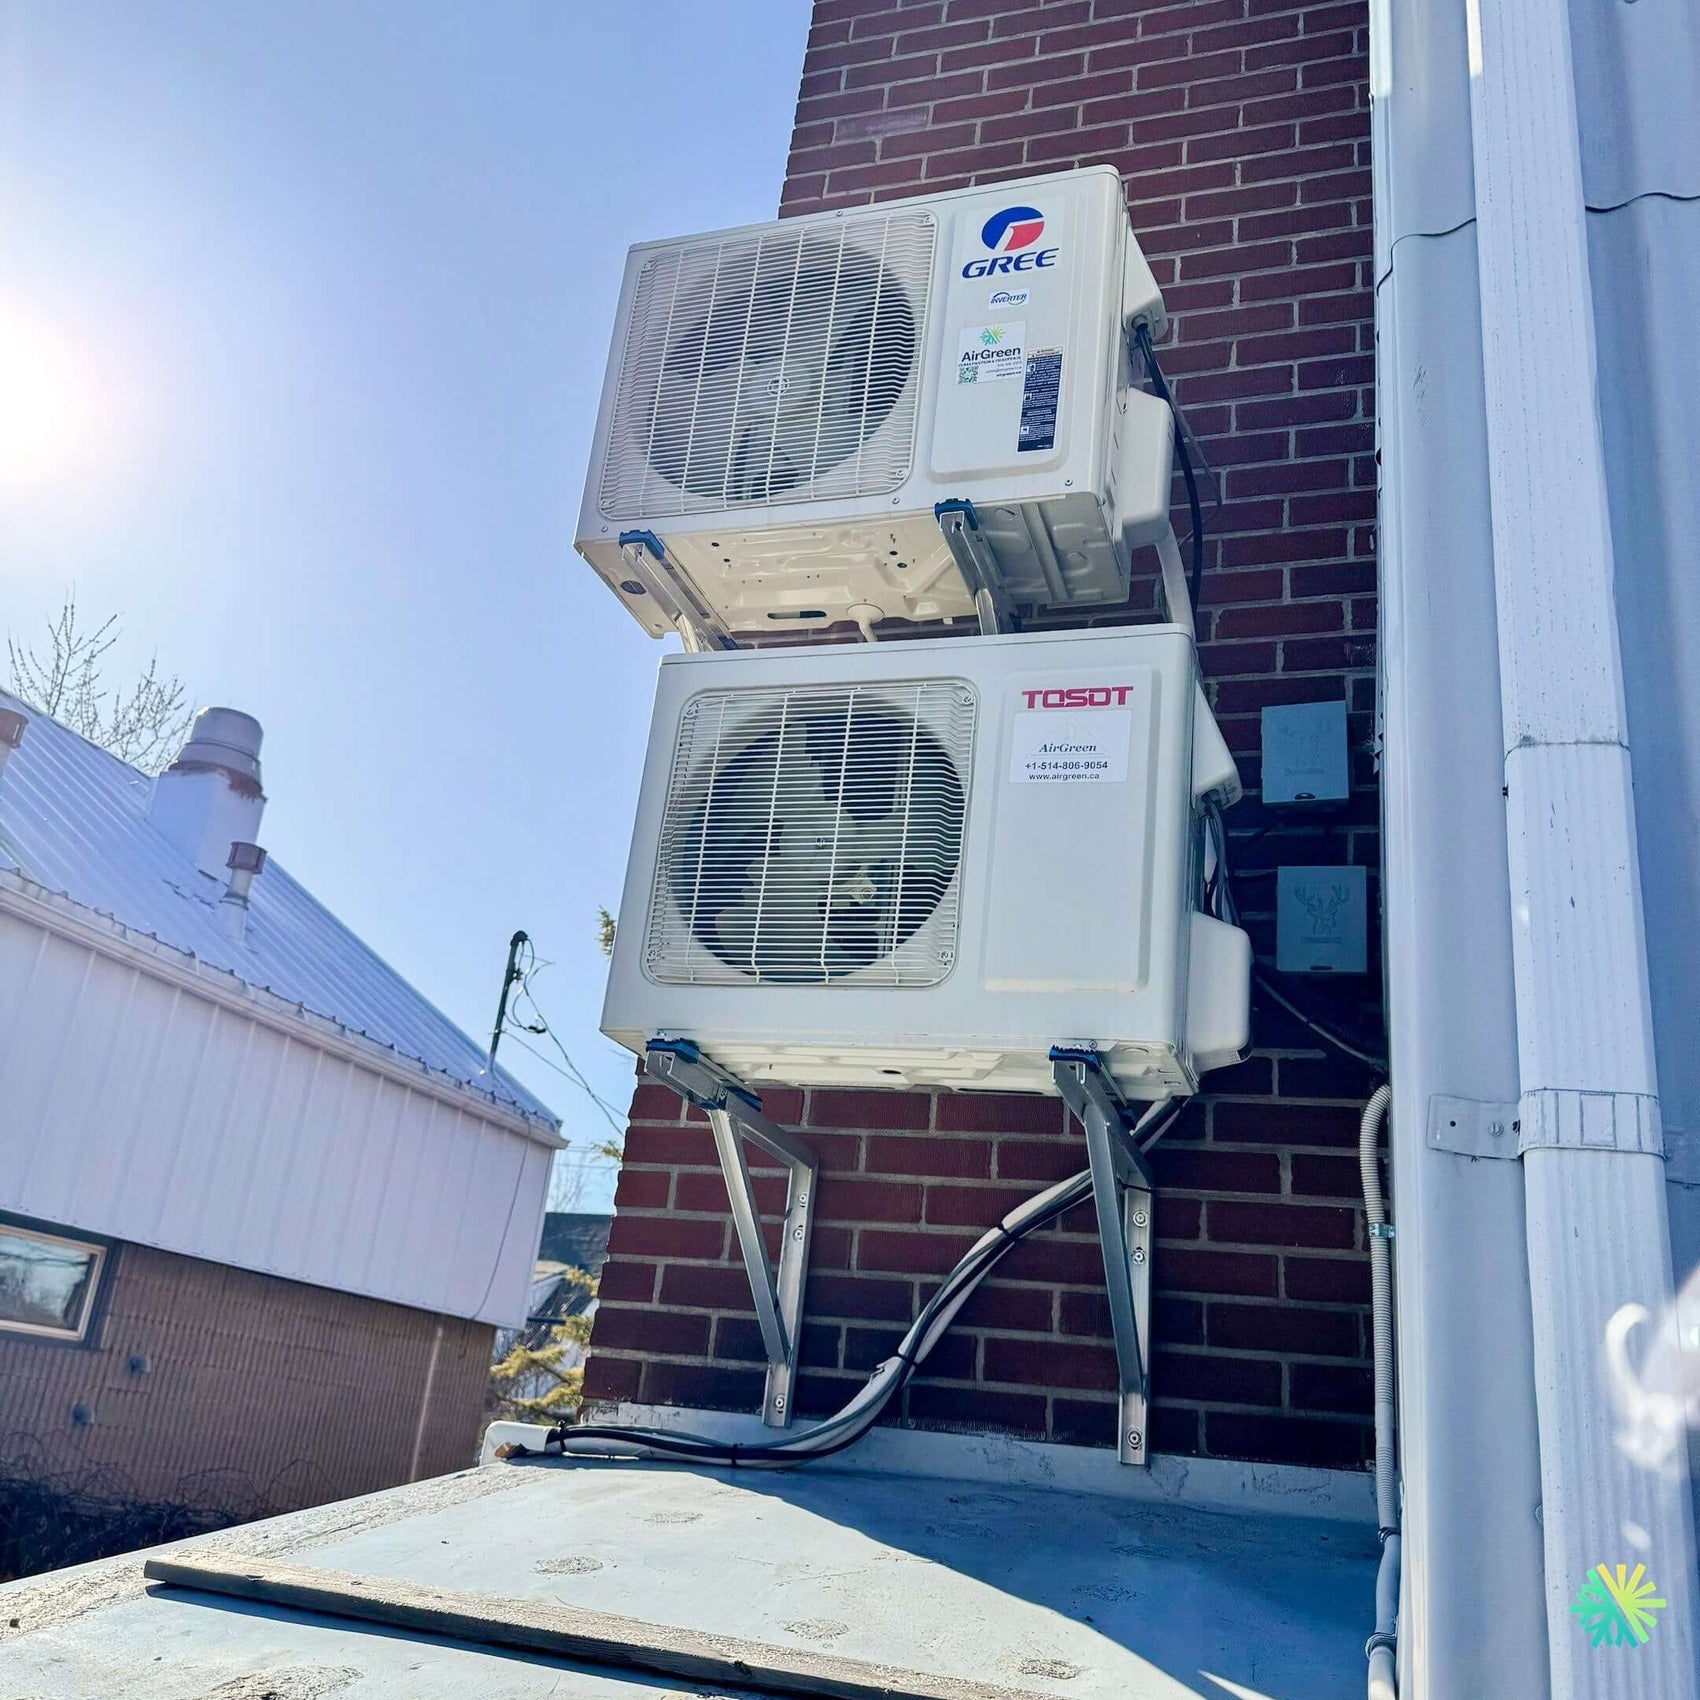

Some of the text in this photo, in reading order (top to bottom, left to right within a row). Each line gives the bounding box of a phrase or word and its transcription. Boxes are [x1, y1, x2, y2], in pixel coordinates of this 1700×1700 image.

[962, 248, 1059, 279] GREE
[961, 347, 1021, 362] AirGreen
[1022, 686, 1134, 709] TOSOT
[1039, 743, 1097, 753] AirGreen
[1025, 761, 1108, 770] +1-514-806-9054
[1029, 773, 1100, 781] www.airgreen.ca
